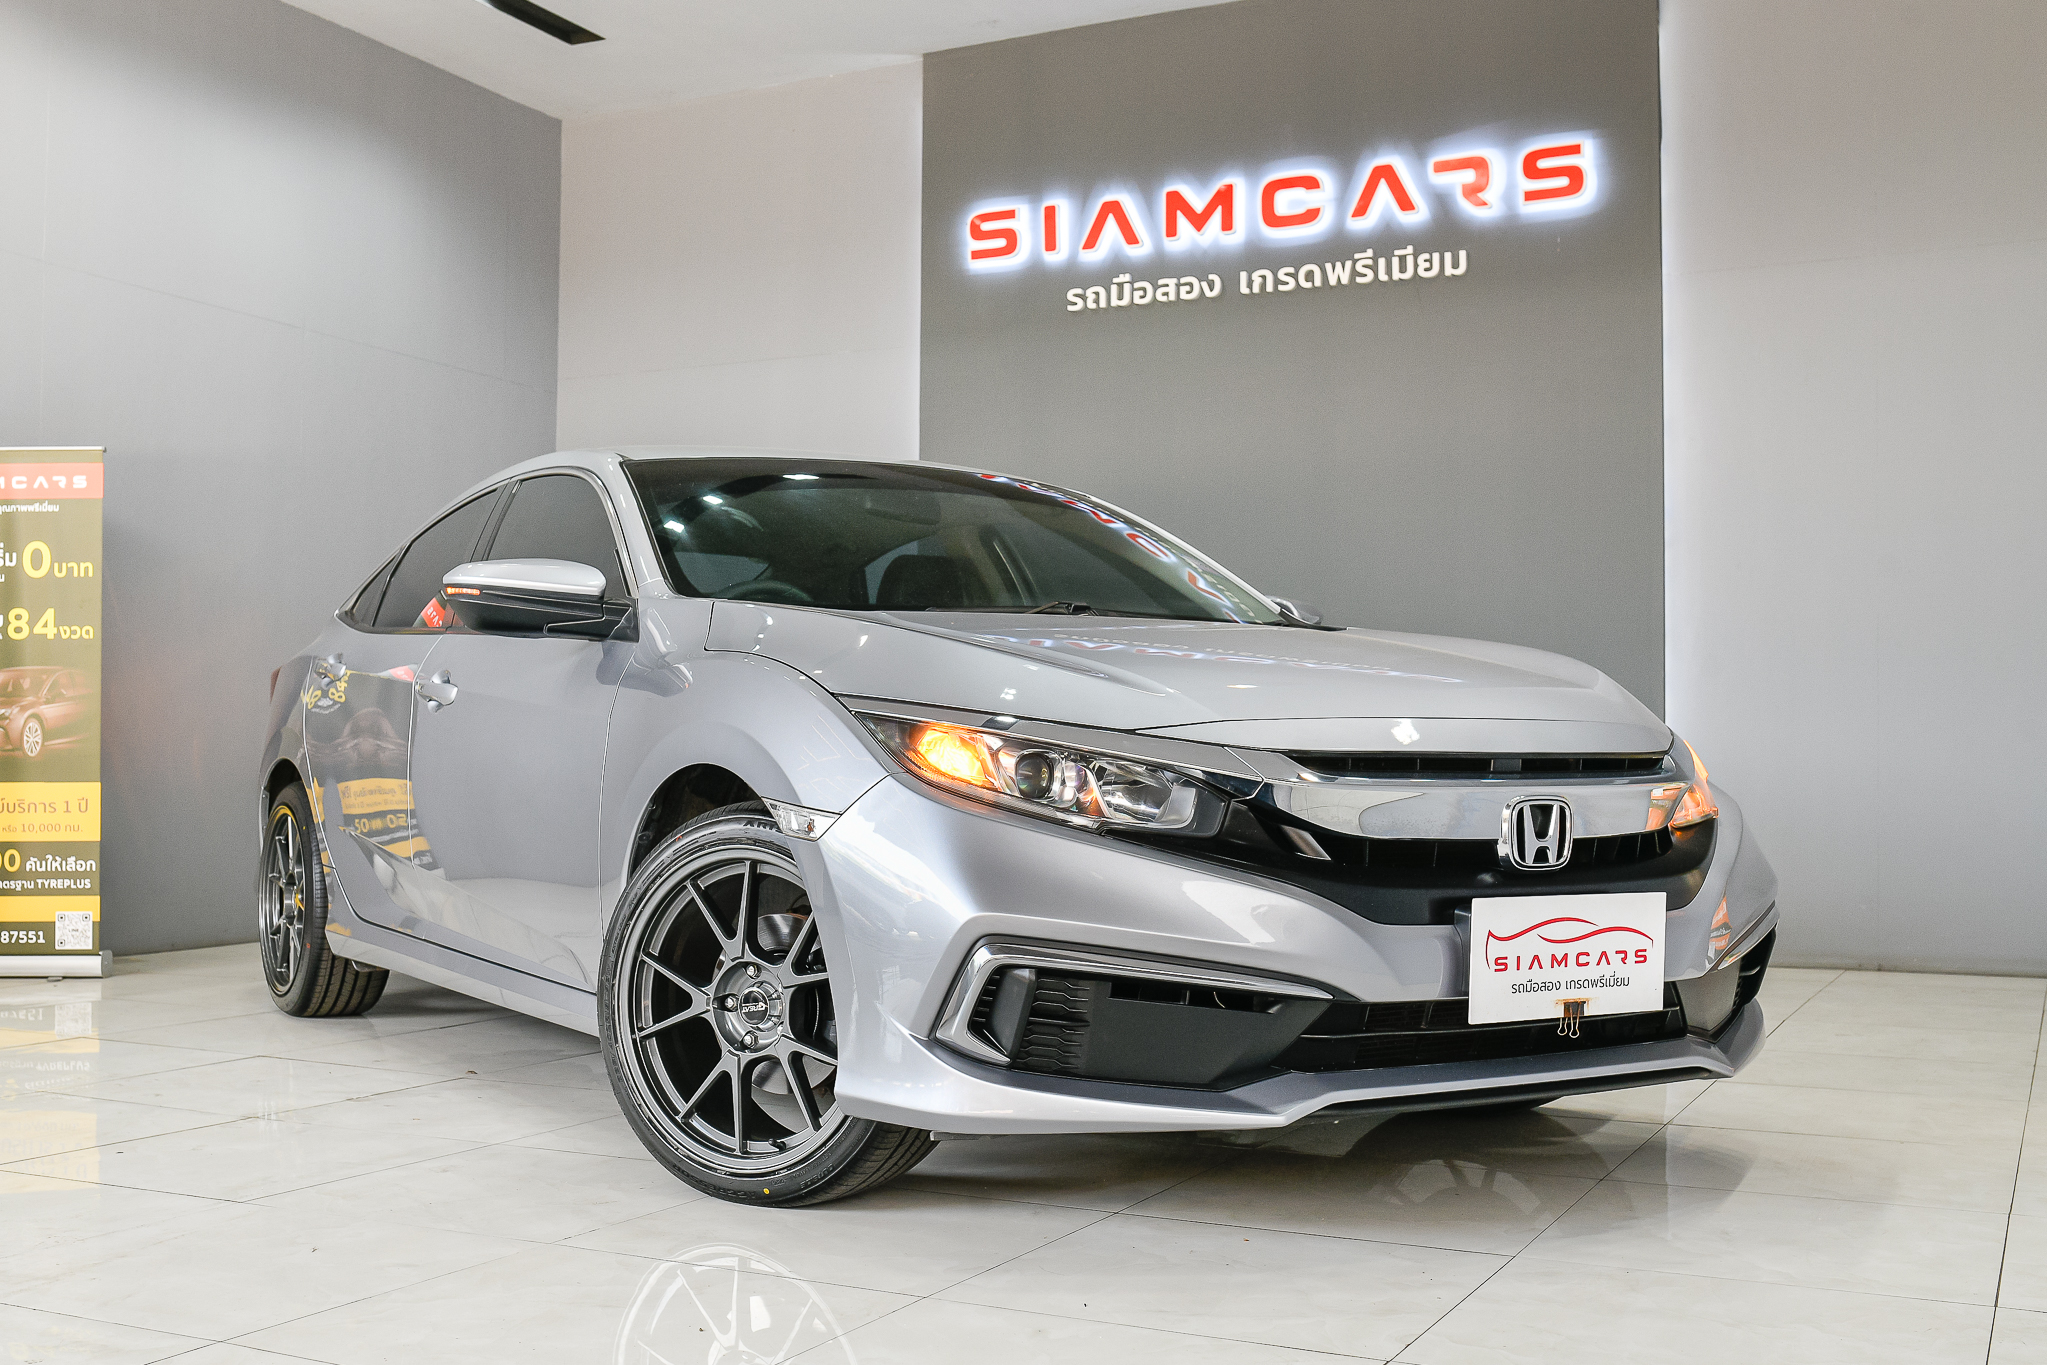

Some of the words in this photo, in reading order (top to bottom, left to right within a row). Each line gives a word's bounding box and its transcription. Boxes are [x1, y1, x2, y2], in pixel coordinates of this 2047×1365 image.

[968, 143, 1587, 262] SIAMCARS
[1066, 272, 1223, 312] รถมือสอง
[1239, 245, 1468, 296] เกรดพรีเมียม
[63, 800, 72, 813] 1
[77, 797, 89, 813] ปี
[21, 823, 61, 834] 10,000
[25, 854, 96, 872] คันให้เลือก
[36, 878, 91, 889] TYREPLUS
[0, 930, 46, 944] 87551
[1493, 948, 1648, 973] SIAMCARS
[1511, 978, 1562, 994] รถมือสอง
[1565, 971, 1630, 990] เกรดพรีเมี่ยม
